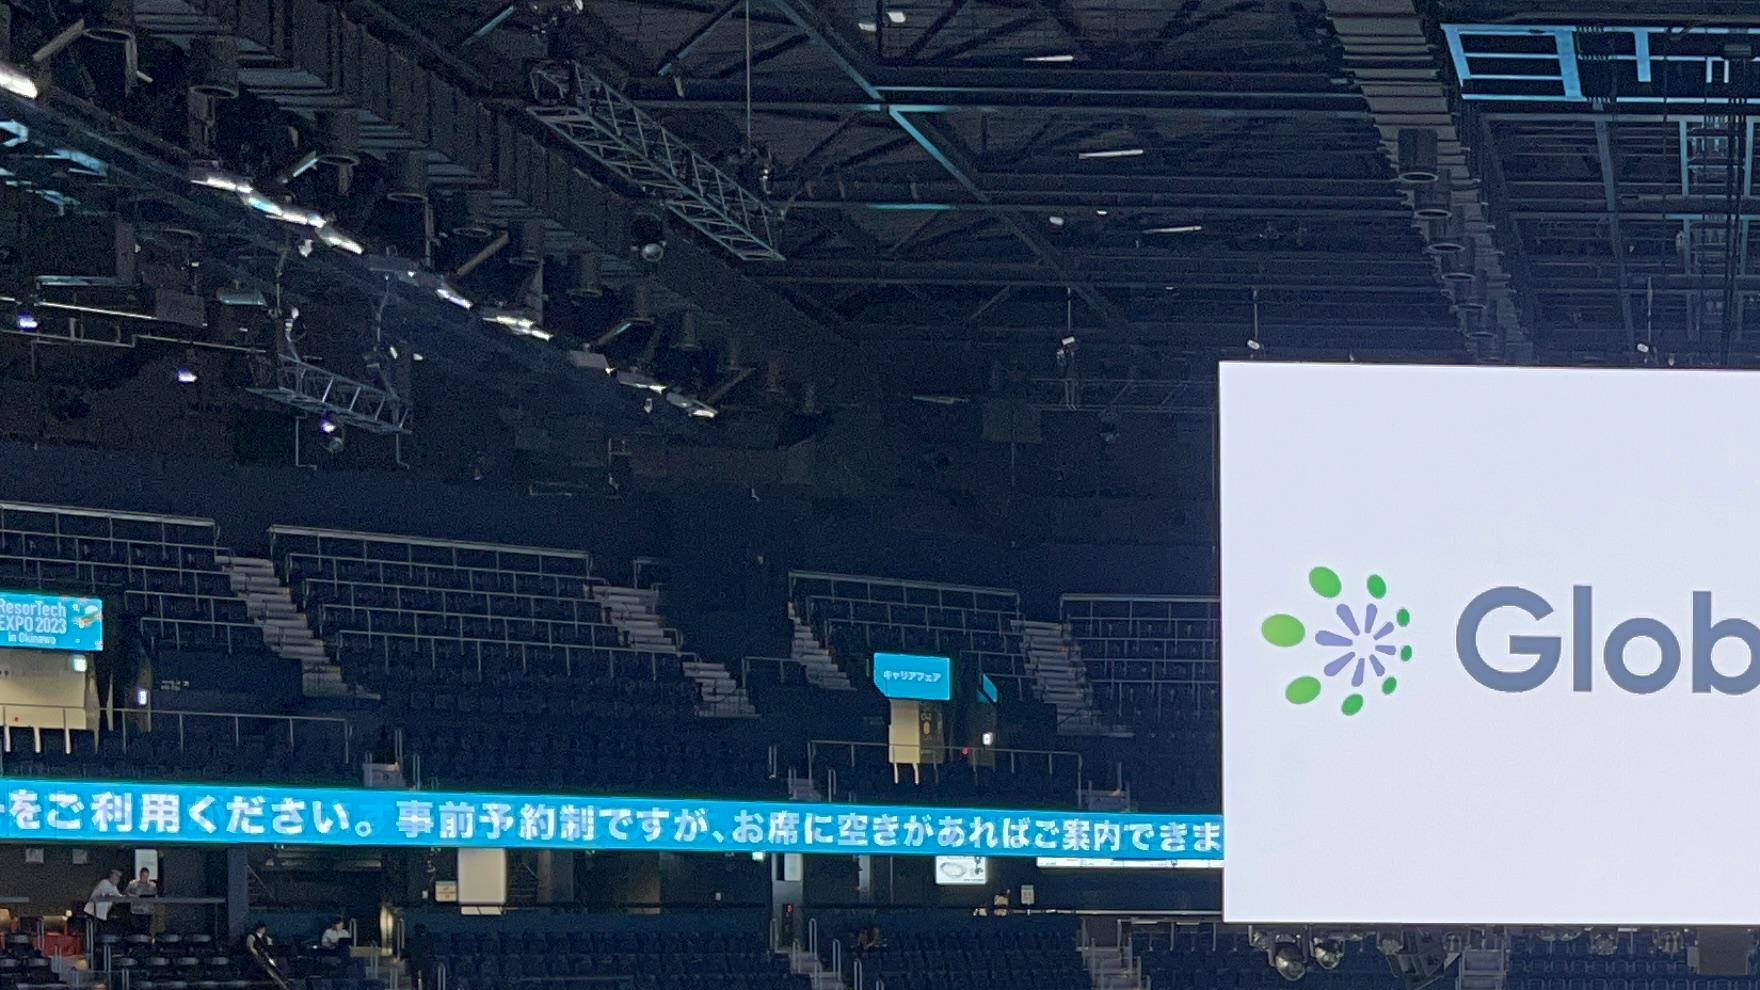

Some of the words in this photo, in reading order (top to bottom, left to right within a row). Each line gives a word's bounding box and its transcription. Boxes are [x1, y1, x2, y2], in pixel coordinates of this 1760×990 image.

[36, 617, 67, 633] 2023
[882, 668, 942, 684] キャリアフェア
